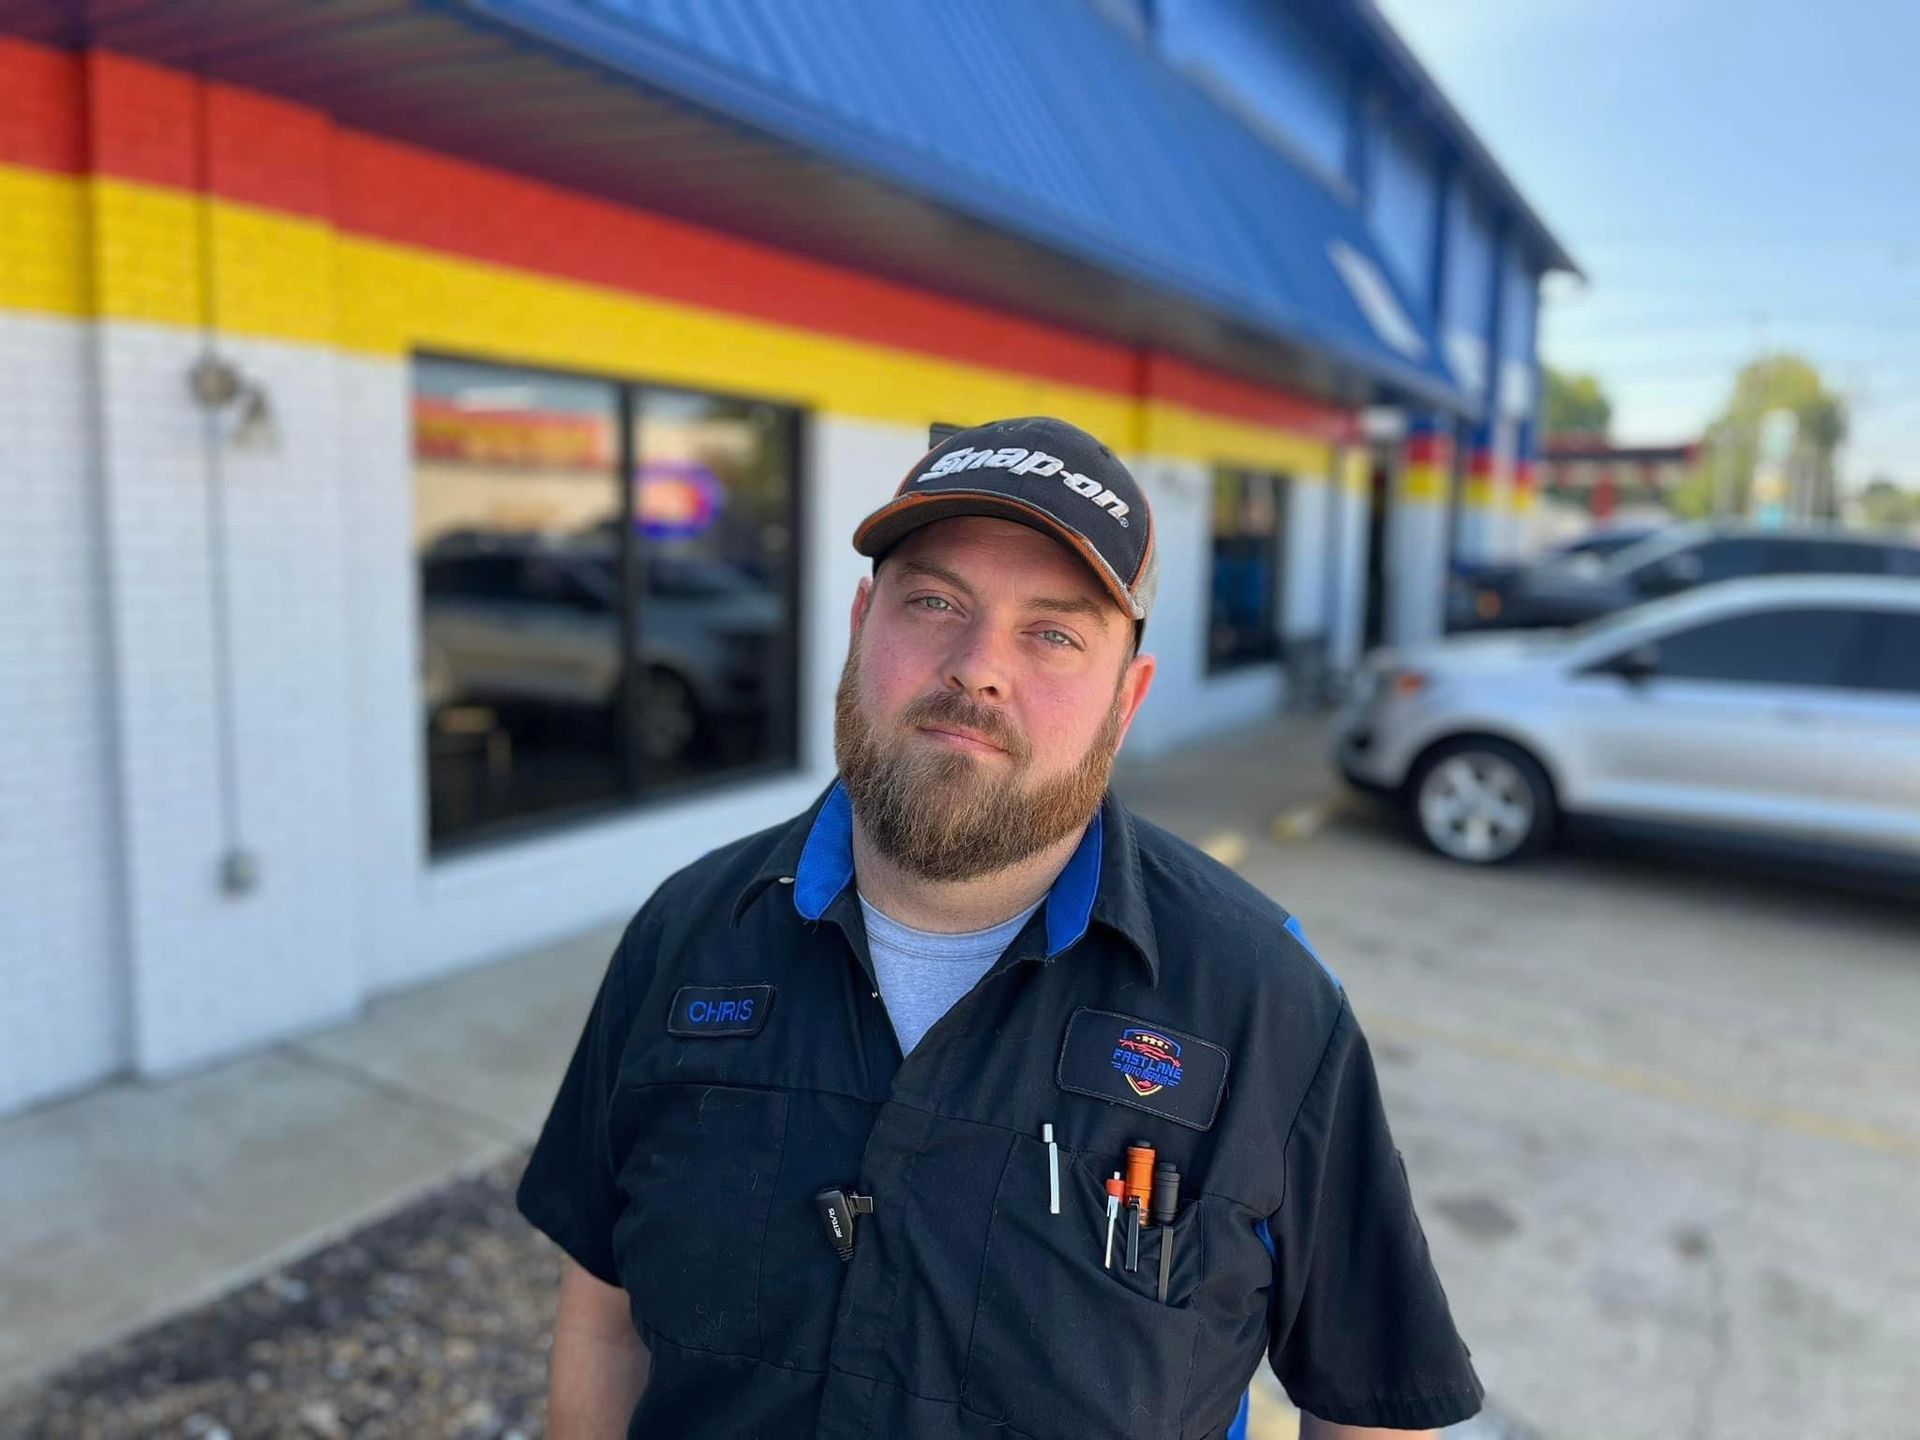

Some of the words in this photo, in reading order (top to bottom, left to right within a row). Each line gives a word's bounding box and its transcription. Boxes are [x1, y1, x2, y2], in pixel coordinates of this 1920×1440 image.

[689, 999, 754, 1022] CHRIS
[1113, 1048, 1149, 1067] FAST
[1147, 1059, 1183, 1080] LANE
[1121, 1063, 1142, 1078] AUTO
